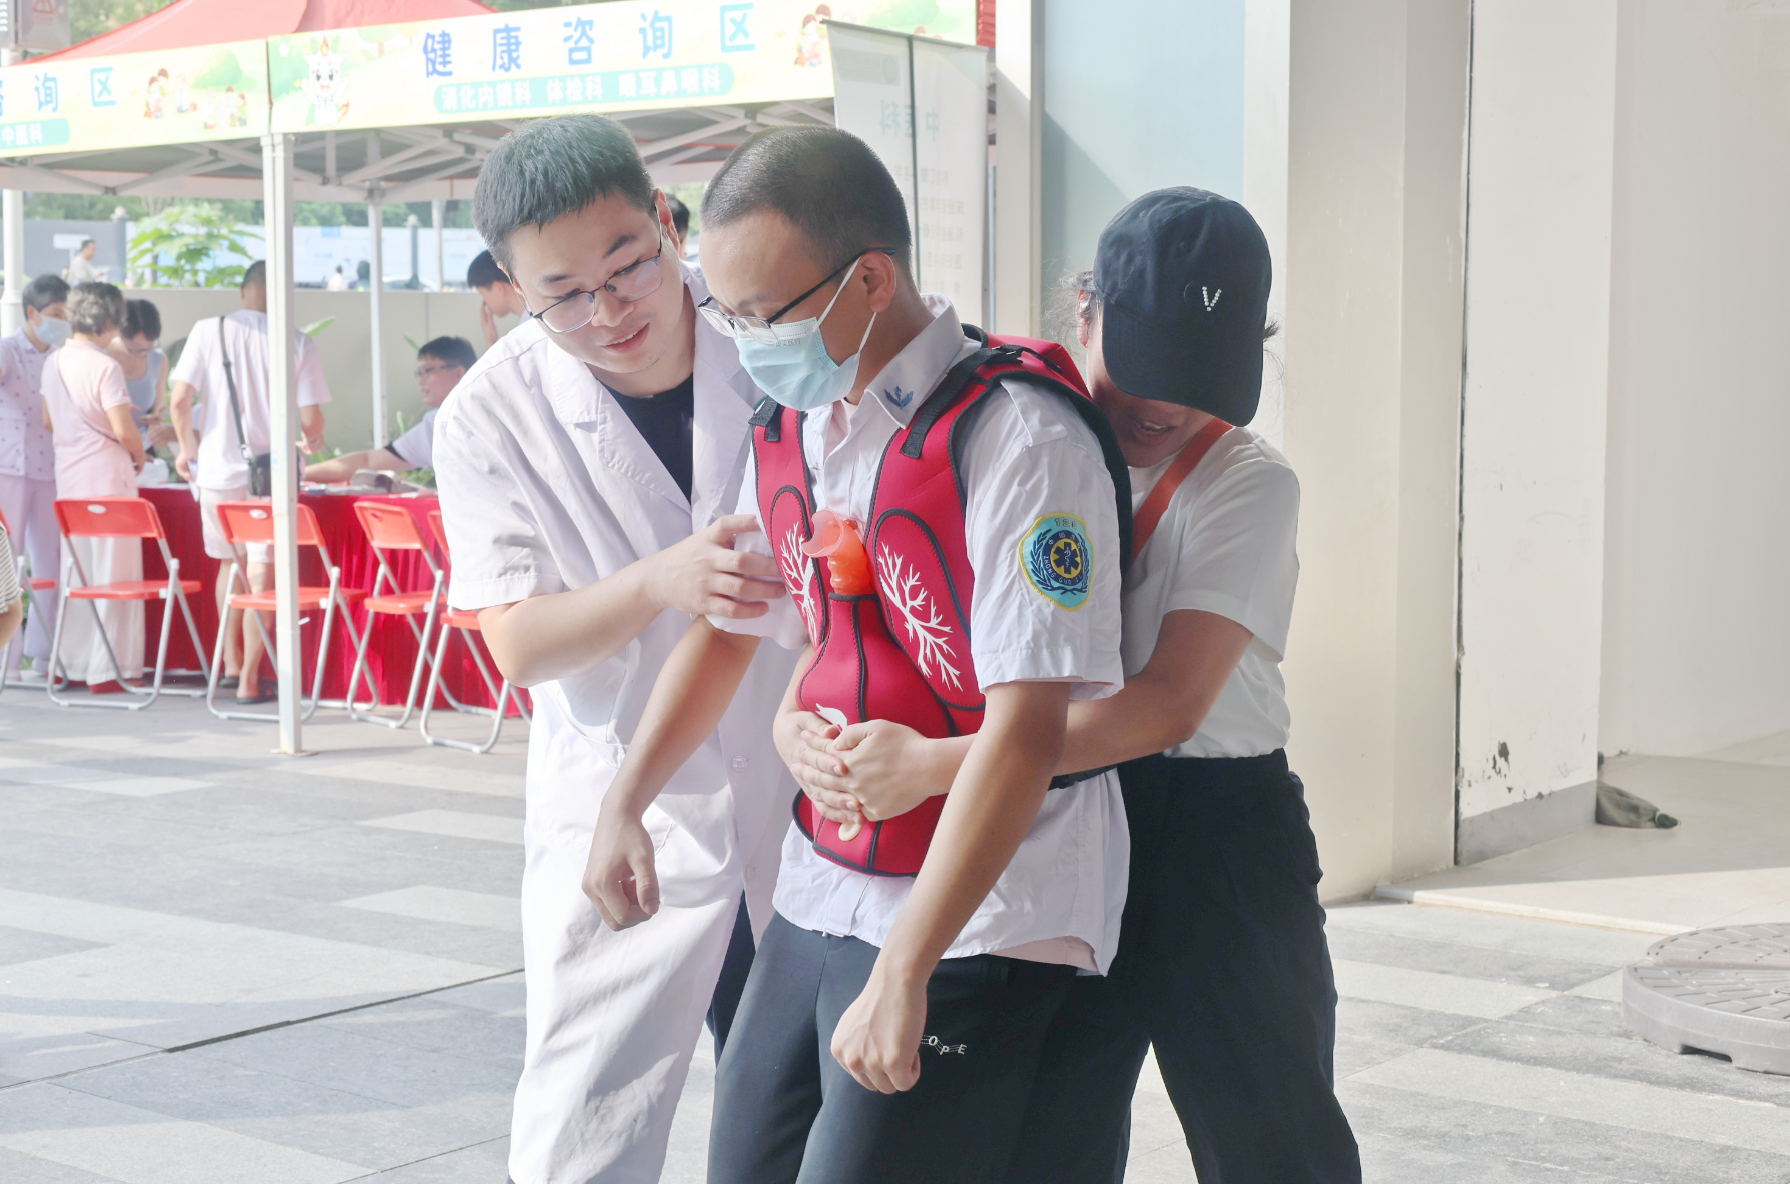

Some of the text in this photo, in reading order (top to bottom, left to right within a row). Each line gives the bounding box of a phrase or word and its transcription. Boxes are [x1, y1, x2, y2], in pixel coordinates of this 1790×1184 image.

[422, 2, 756, 78] 健康咨询区
[0, 66, 116, 117] 询区
[546, 75, 603, 104] 体检科
[619, 66, 721, 98] 眼耳鼻喉科
[1, 122, 43, 147] 中医科
[1201, 286, 1222, 312] V
[1043, 555, 1057, 578] ZHONG
[928, 1035, 968, 1056] OPE
